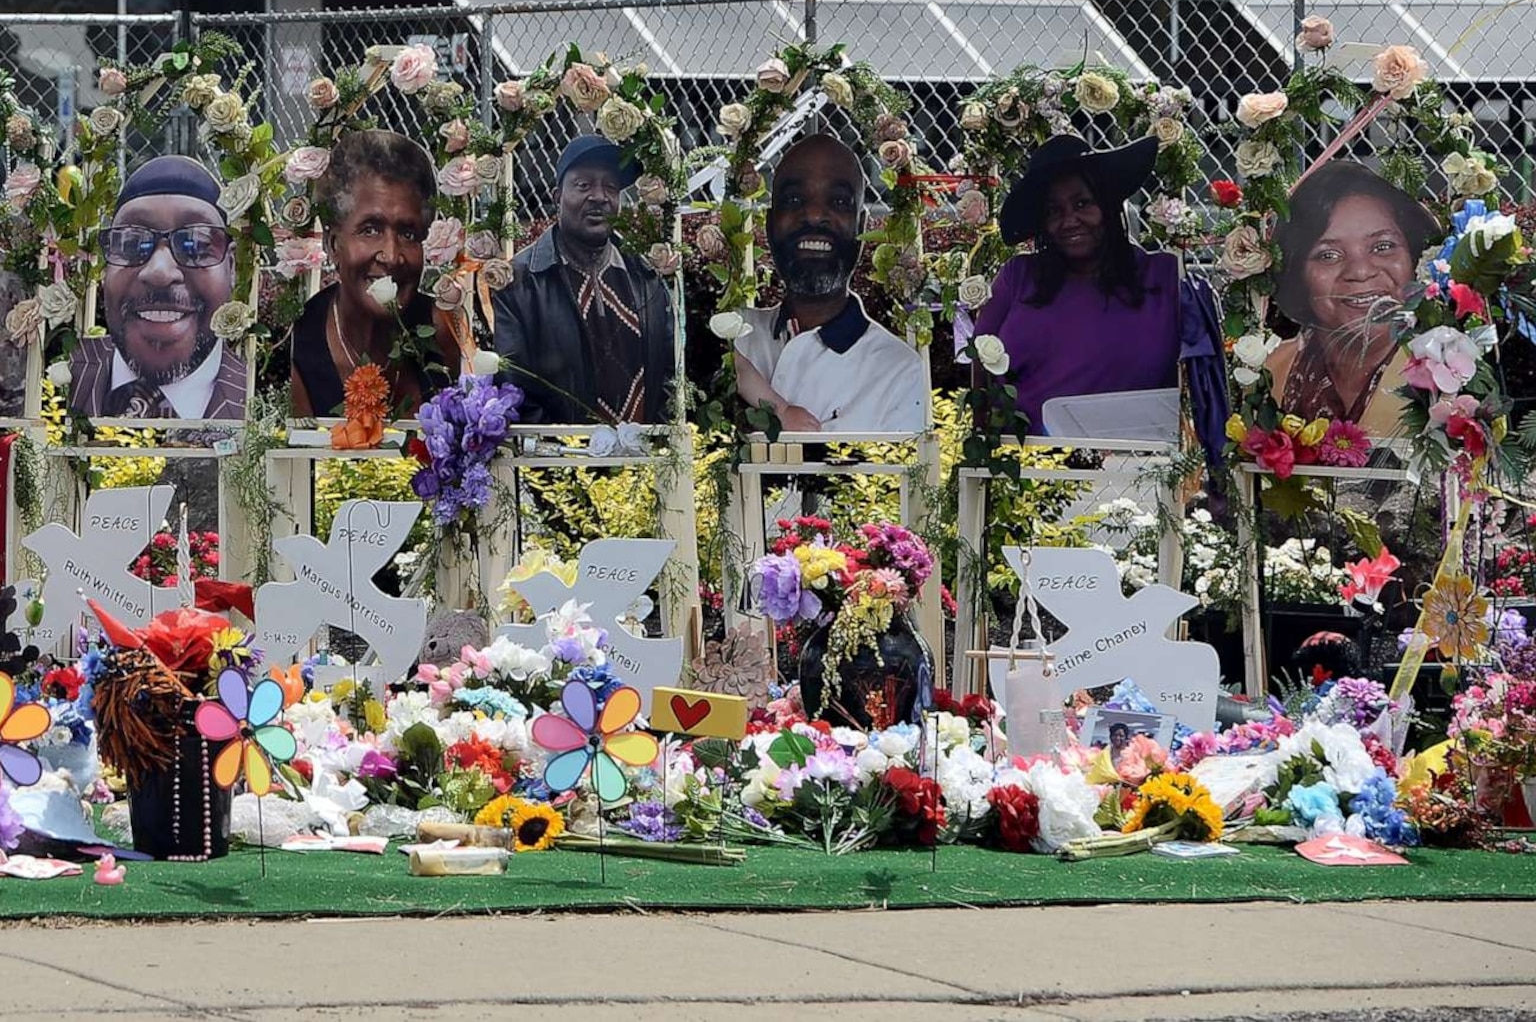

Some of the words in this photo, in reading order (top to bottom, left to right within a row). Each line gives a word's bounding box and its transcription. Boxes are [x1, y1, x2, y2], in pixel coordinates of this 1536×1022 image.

[90, 515, 140, 531] PEACE
[337, 528, 389, 546] PEACE
[586, 564, 639, 582] PEACE
[64, 560, 91, 584] Ruth
[93, 578, 146, 619] Whitfield
[1037, 575, 1099, 590] PEACE
[300, 564, 341, 598] Margus
[343, 593, 395, 635] Morrison
[264, 631, 298, 645] 5-14-22
[1094, 619, 1148, 653] Chaney
[1160, 691, 1204, 703] 5-14-22
